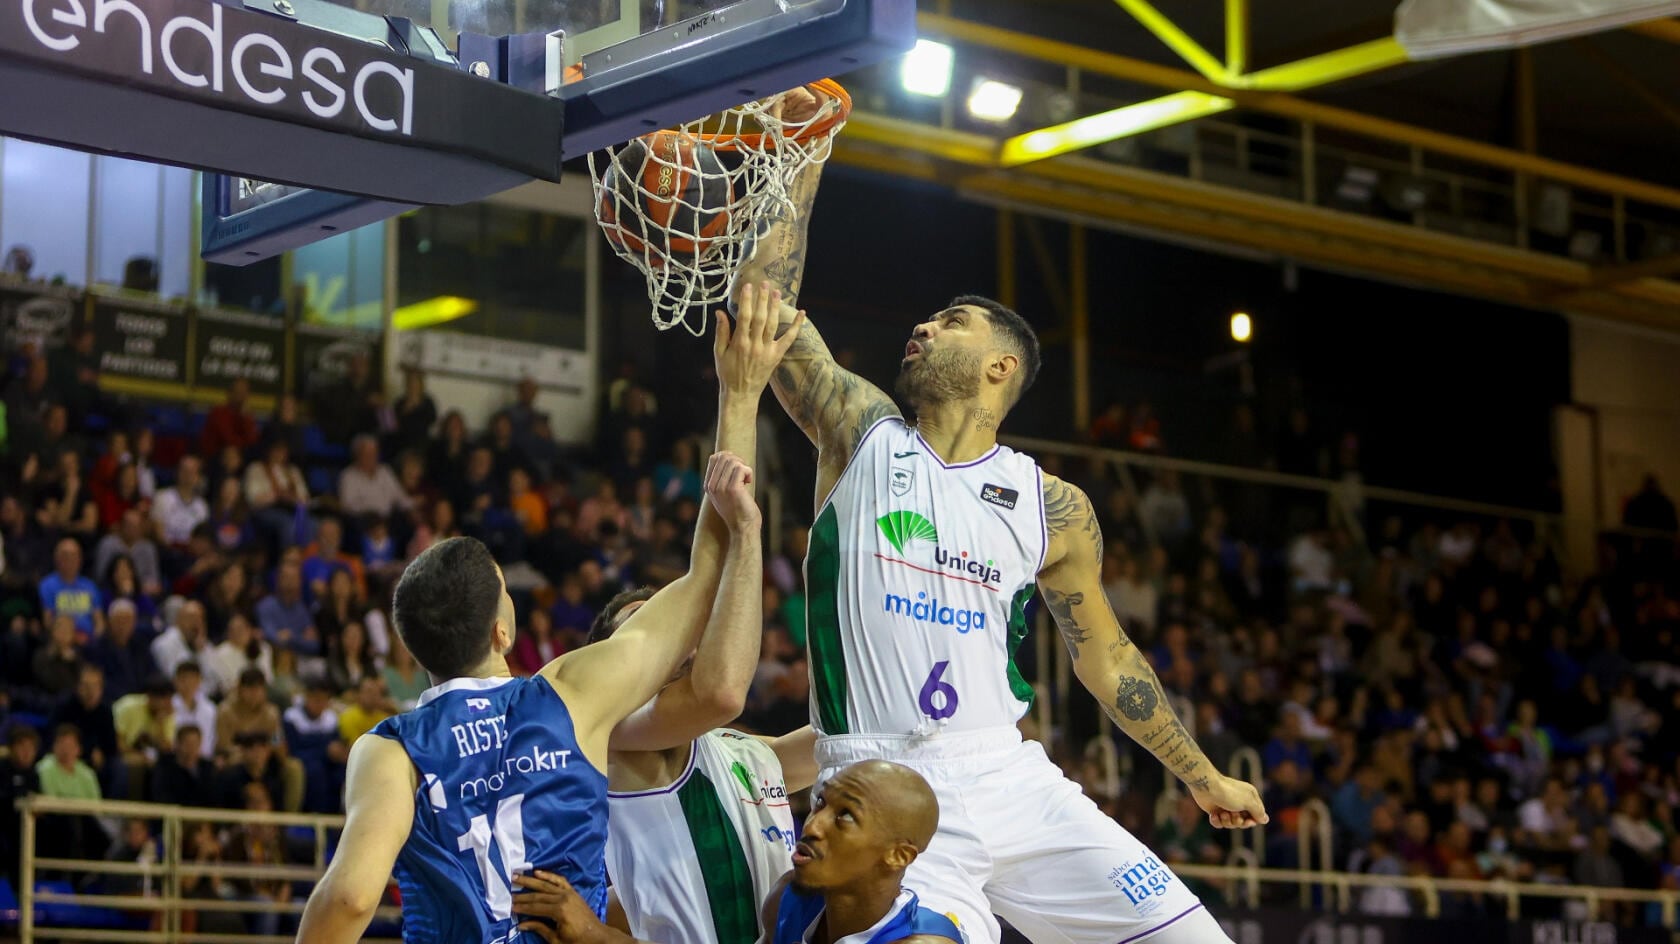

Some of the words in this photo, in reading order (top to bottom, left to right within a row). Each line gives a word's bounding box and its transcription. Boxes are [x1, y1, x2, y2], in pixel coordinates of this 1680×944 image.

[22, 0, 414, 135] endesa
[918, 660, 958, 720] 6
[451, 715, 508, 758] RIST
